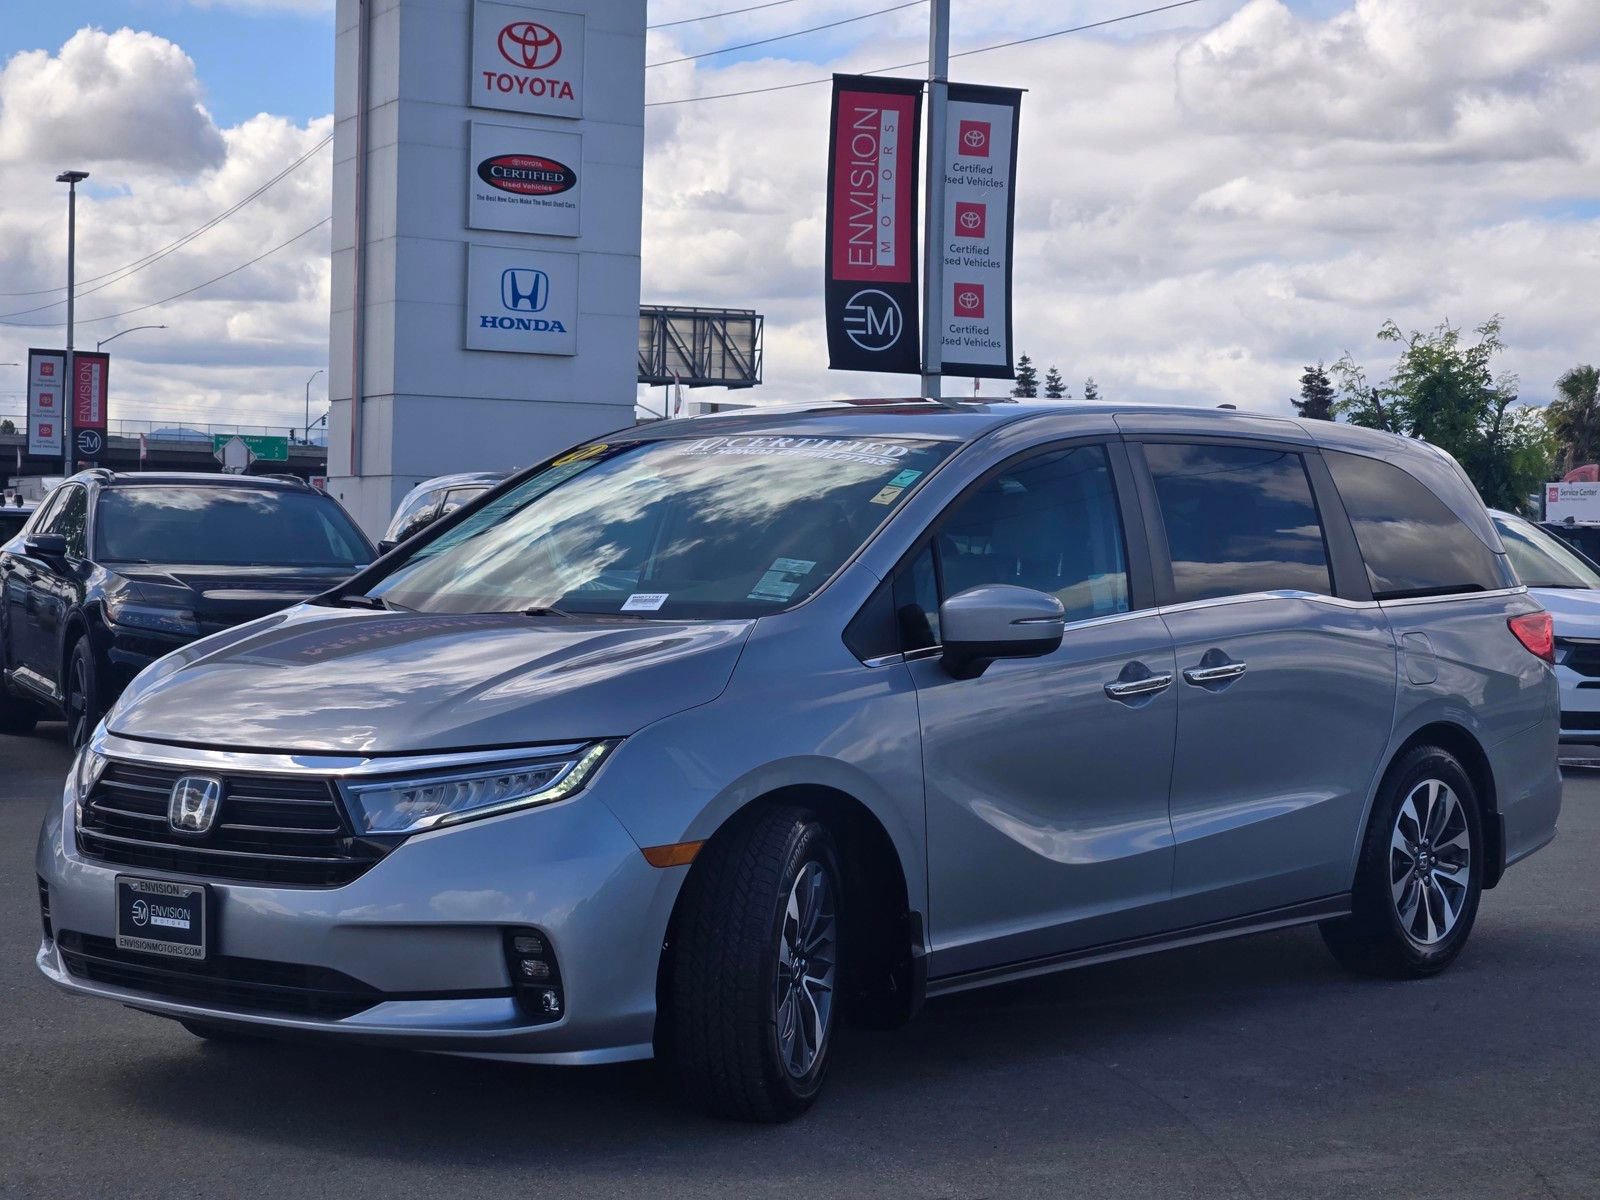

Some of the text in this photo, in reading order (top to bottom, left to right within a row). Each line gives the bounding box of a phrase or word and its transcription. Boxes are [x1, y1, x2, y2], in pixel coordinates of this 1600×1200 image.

[483, 72, 574, 100] TOYOTA
[521, 160, 542, 168] TOYOTA
[952, 163, 993, 175] Certified
[523, 183, 553, 191] Vehicles
[848, 107, 878, 266] ENVISION
[881, 124, 895, 253] MOTORS
[966, 177, 1004, 188] Vehicles
[949, 244, 989, 256] Certified
[944, 257, 1001, 269] sed Vehicles
[480, 315, 567, 333] HONDA
[949, 324, 989, 336] Certified
[964, 338, 1001, 349] Vehicles
[80, 362, 91, 422] ENVISION
[727, 437, 908, 458] CERTIFIED
[1580, 488, 1597, 496] Center
[140, 882, 179, 895] ENVISION
[151, 904, 191, 920] ENVISION
[120, 938, 202, 957] ENVISIONMOTORS.COM
